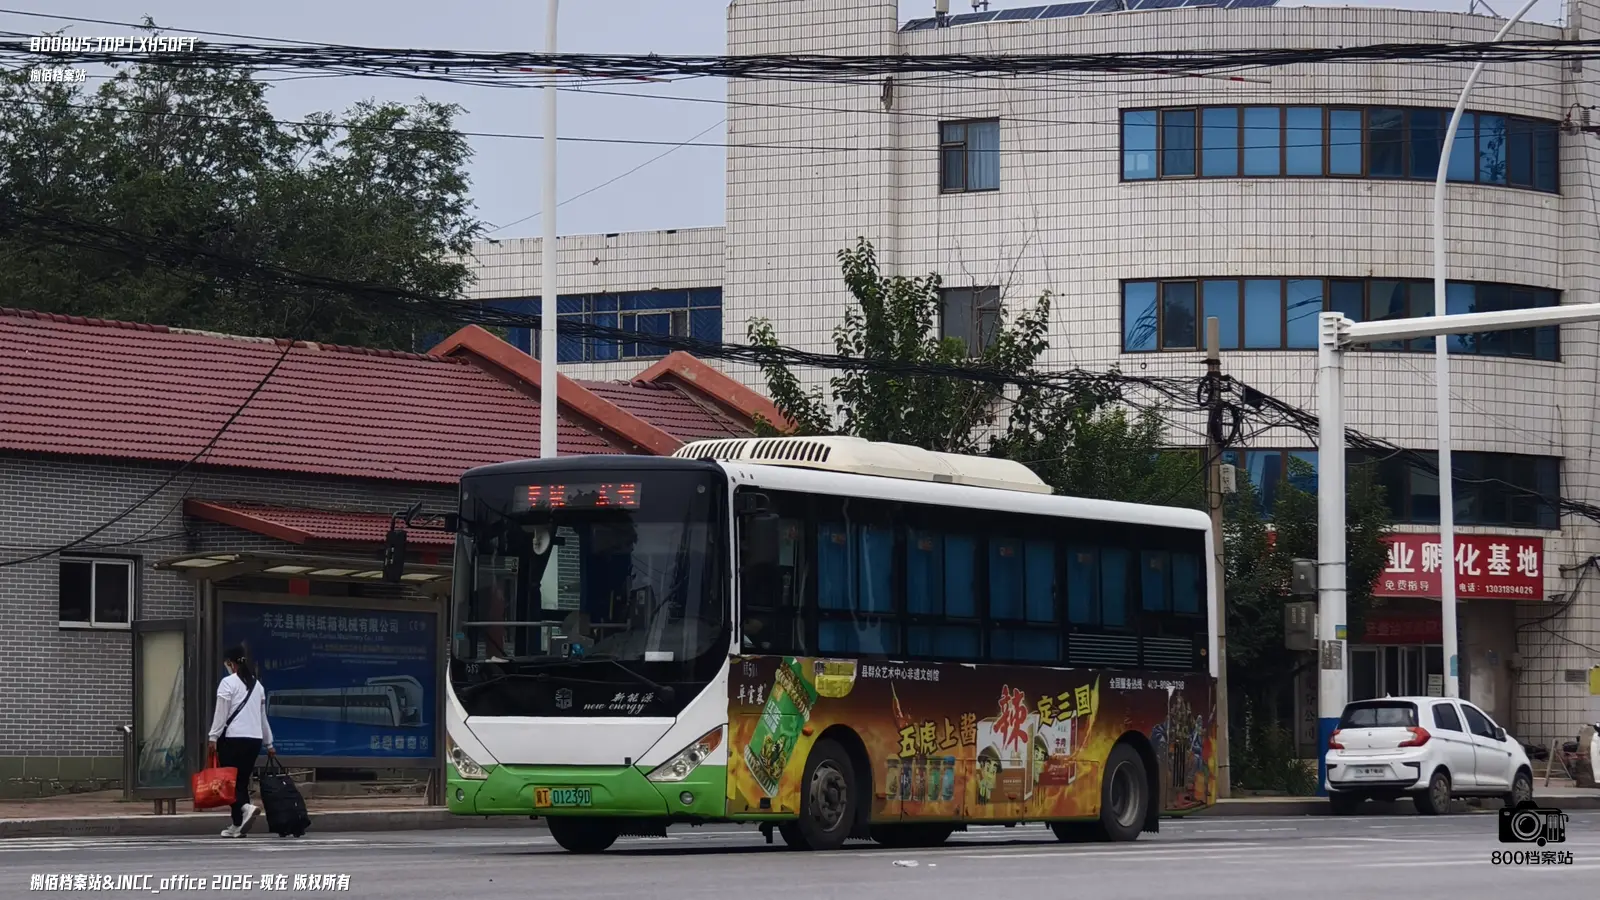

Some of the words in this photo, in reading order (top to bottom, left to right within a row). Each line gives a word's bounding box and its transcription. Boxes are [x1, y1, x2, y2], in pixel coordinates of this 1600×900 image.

[1384, 579, 1430, 592] 免费指导
[861, 665, 940, 682] 县群众艺术中心非遗文创馆
[610, 692, 655, 704] 新能源
[608, 703, 646, 714] energy
